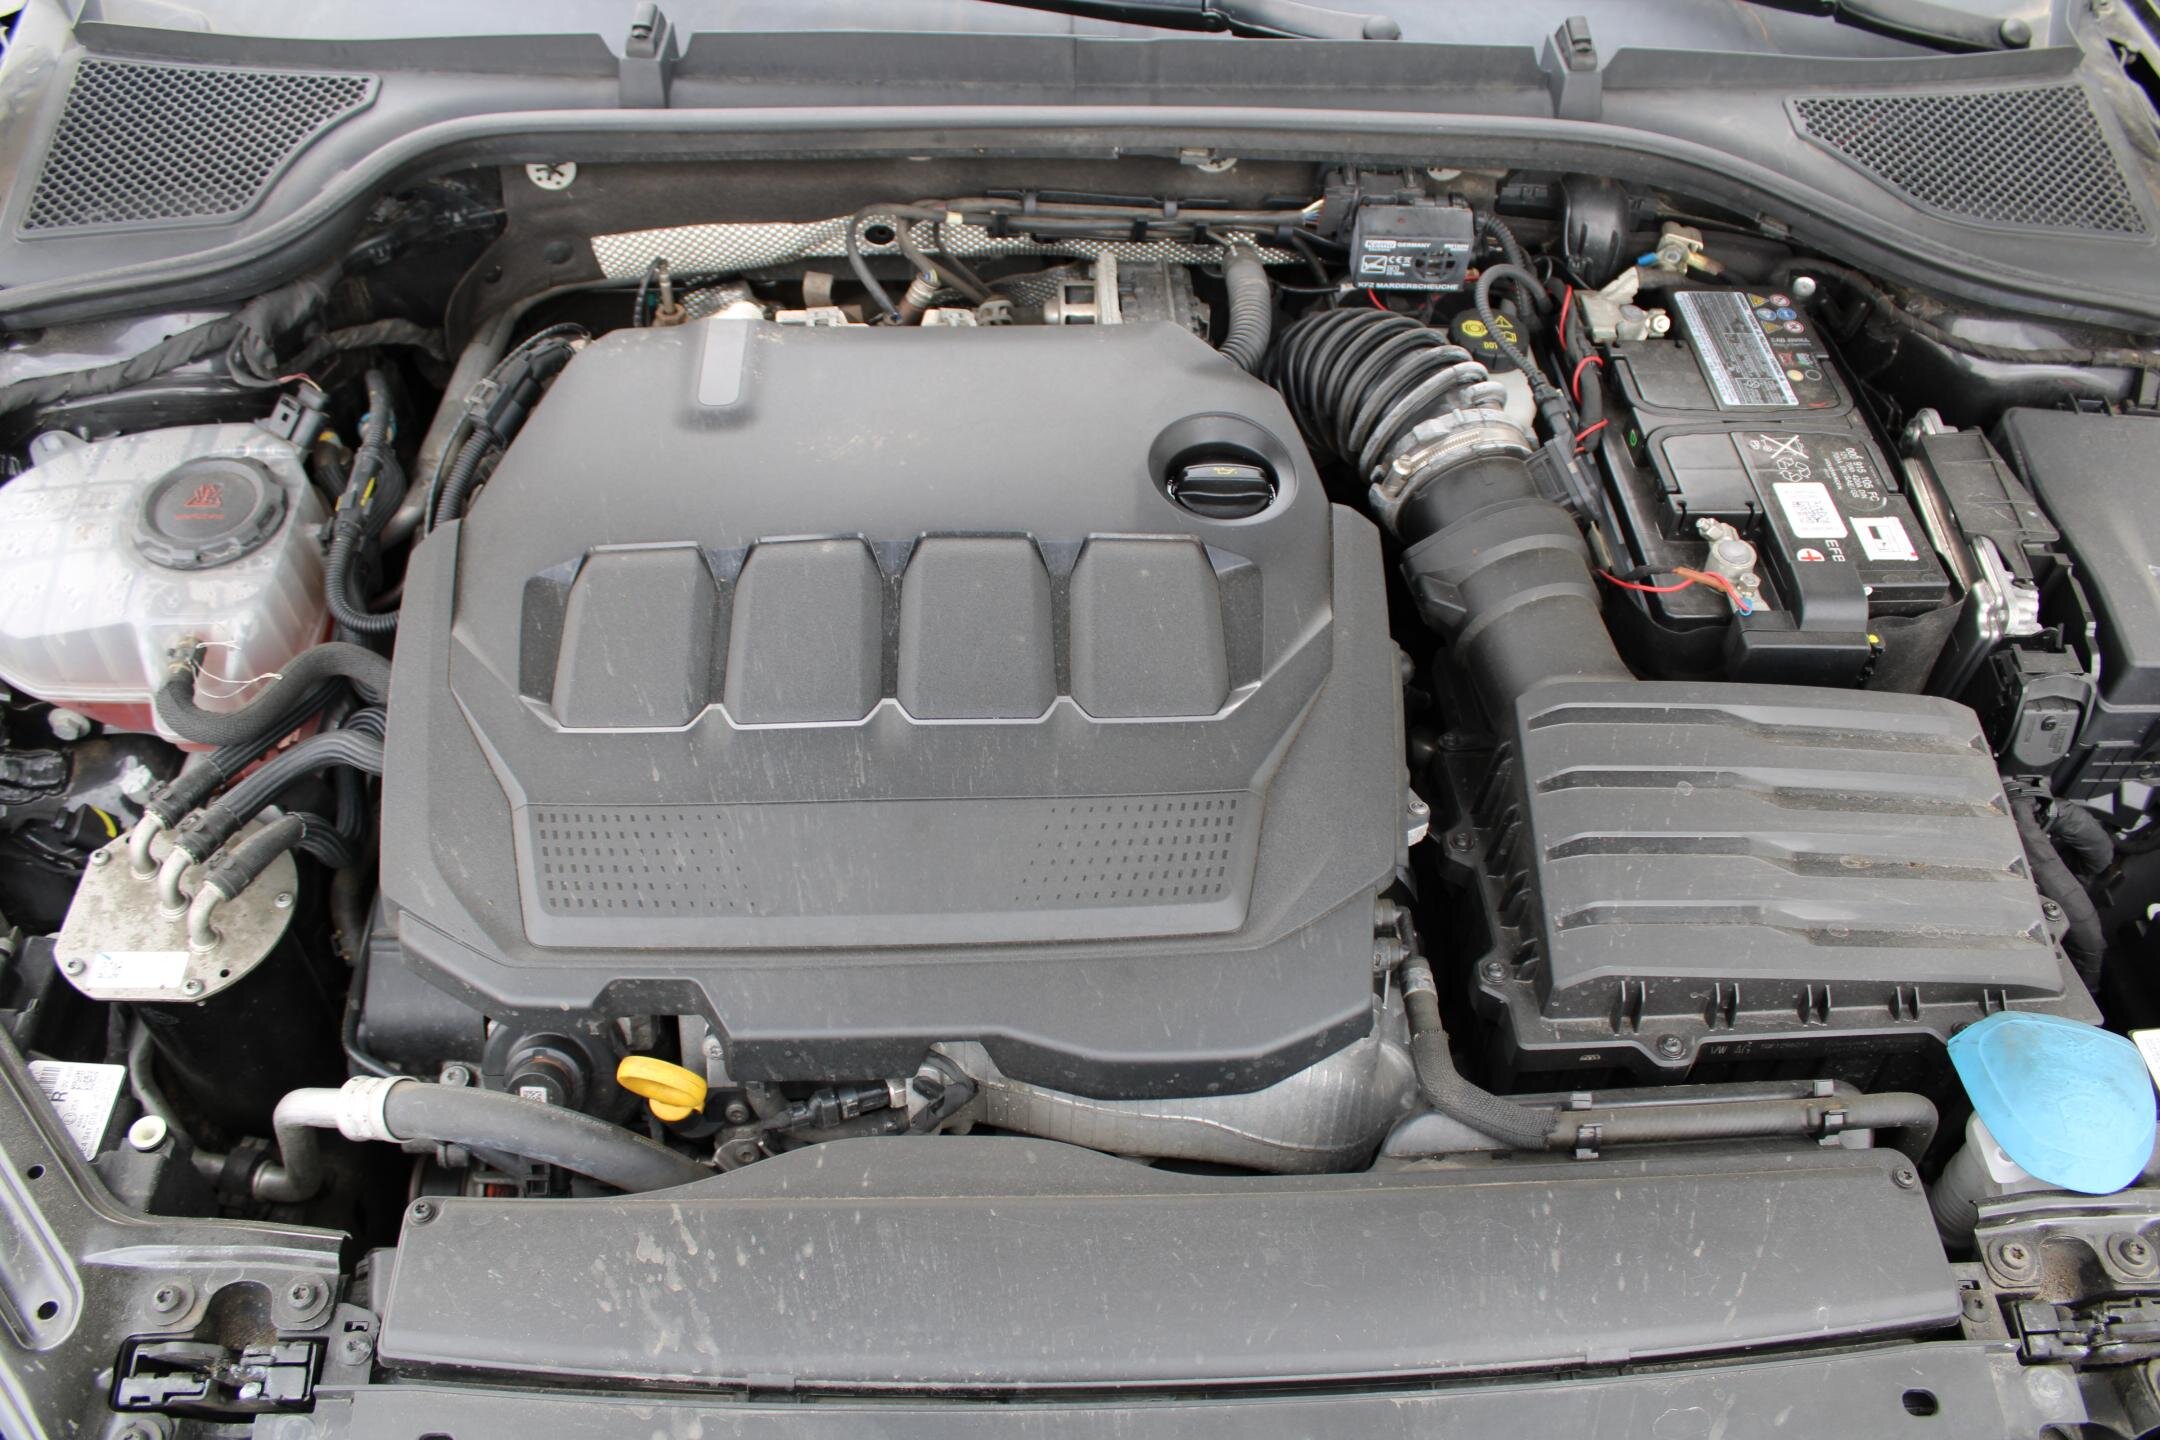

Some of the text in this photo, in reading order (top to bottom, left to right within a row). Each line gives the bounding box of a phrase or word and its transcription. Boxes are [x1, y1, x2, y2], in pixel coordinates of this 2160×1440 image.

[1375, 282, 1459, 290] MARDERSCHEUCHE
[1825, 539, 1846, 562] EFB
[50, 1091, 68, 1102] R
